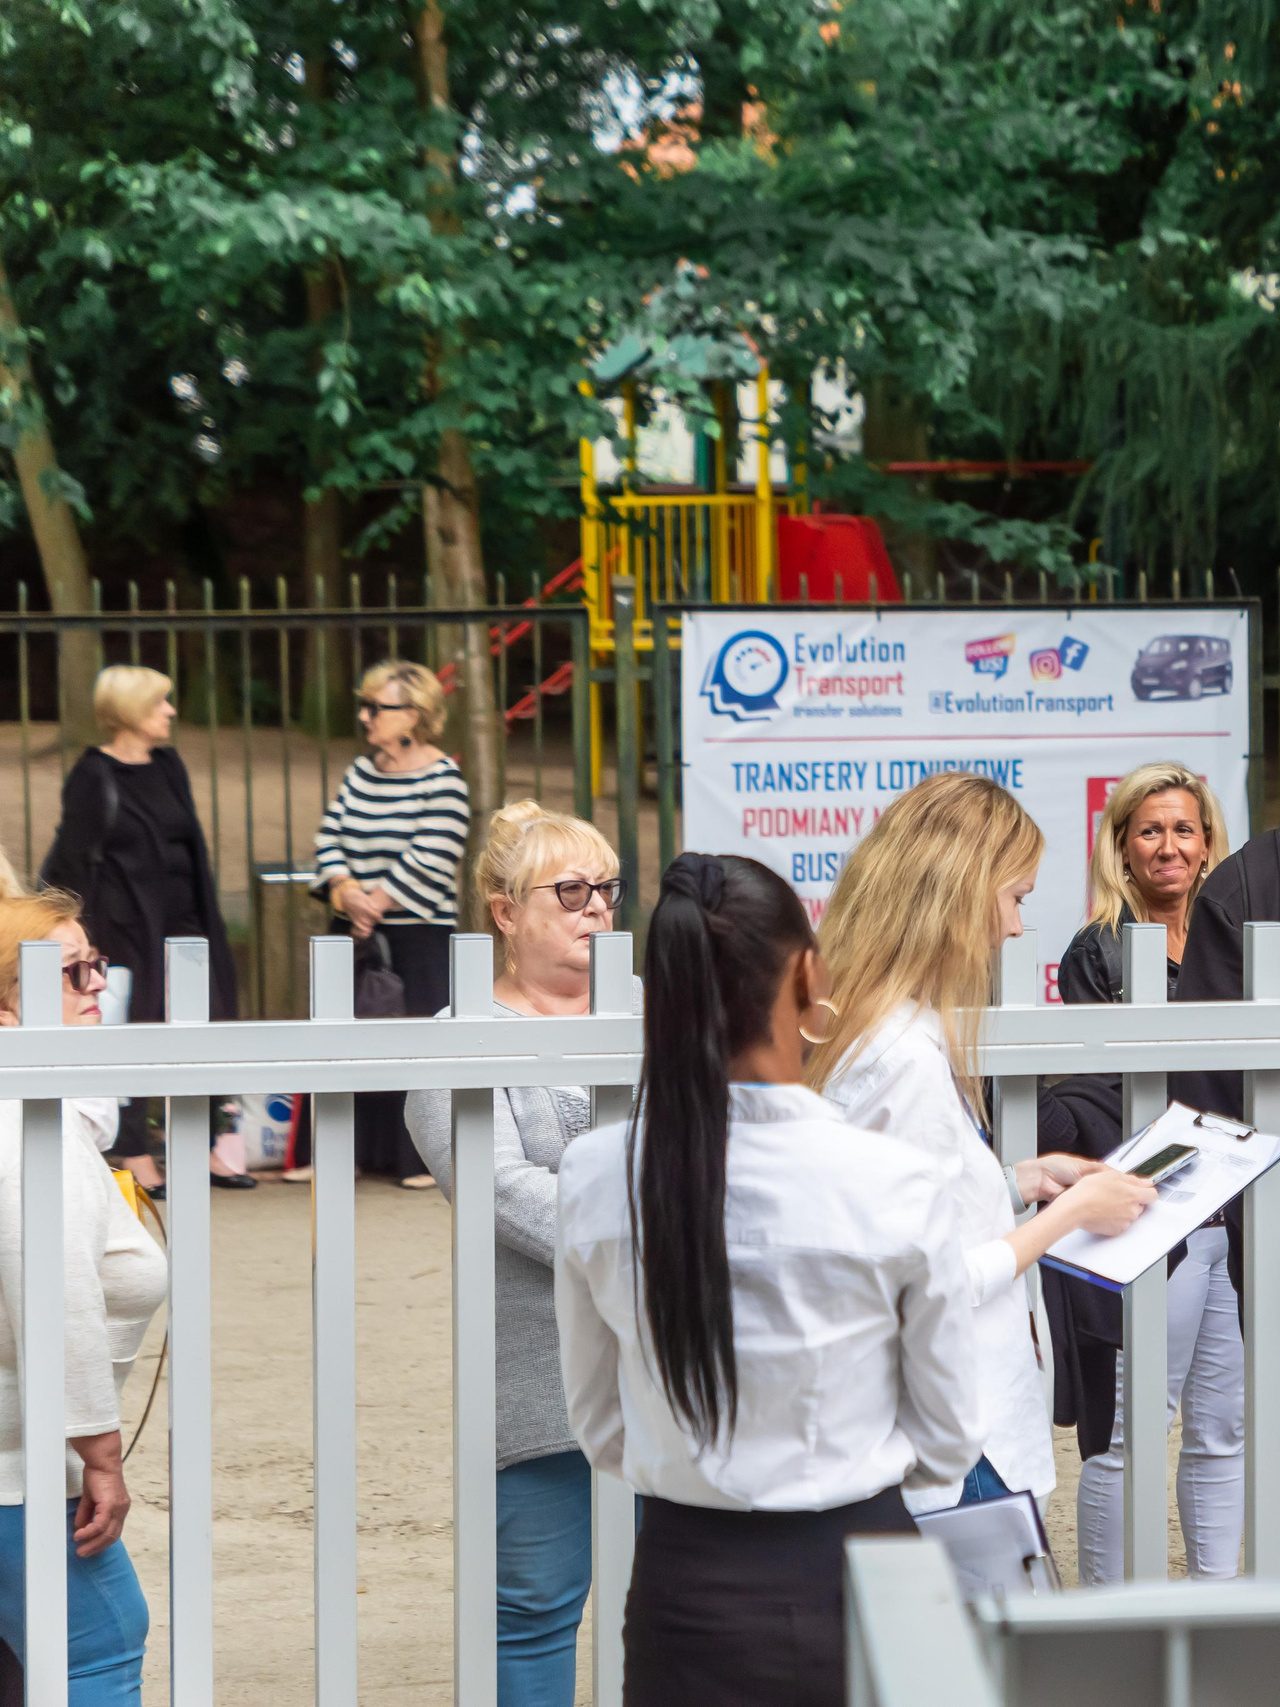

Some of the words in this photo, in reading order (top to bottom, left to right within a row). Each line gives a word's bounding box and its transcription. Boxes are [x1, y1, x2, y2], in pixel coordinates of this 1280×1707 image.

[794, 632, 905, 663] Evolution
[794, 666, 904, 703] Transport
[731, 761, 868, 792] TRANSFERY
[742, 807, 865, 838] PODMIANY
